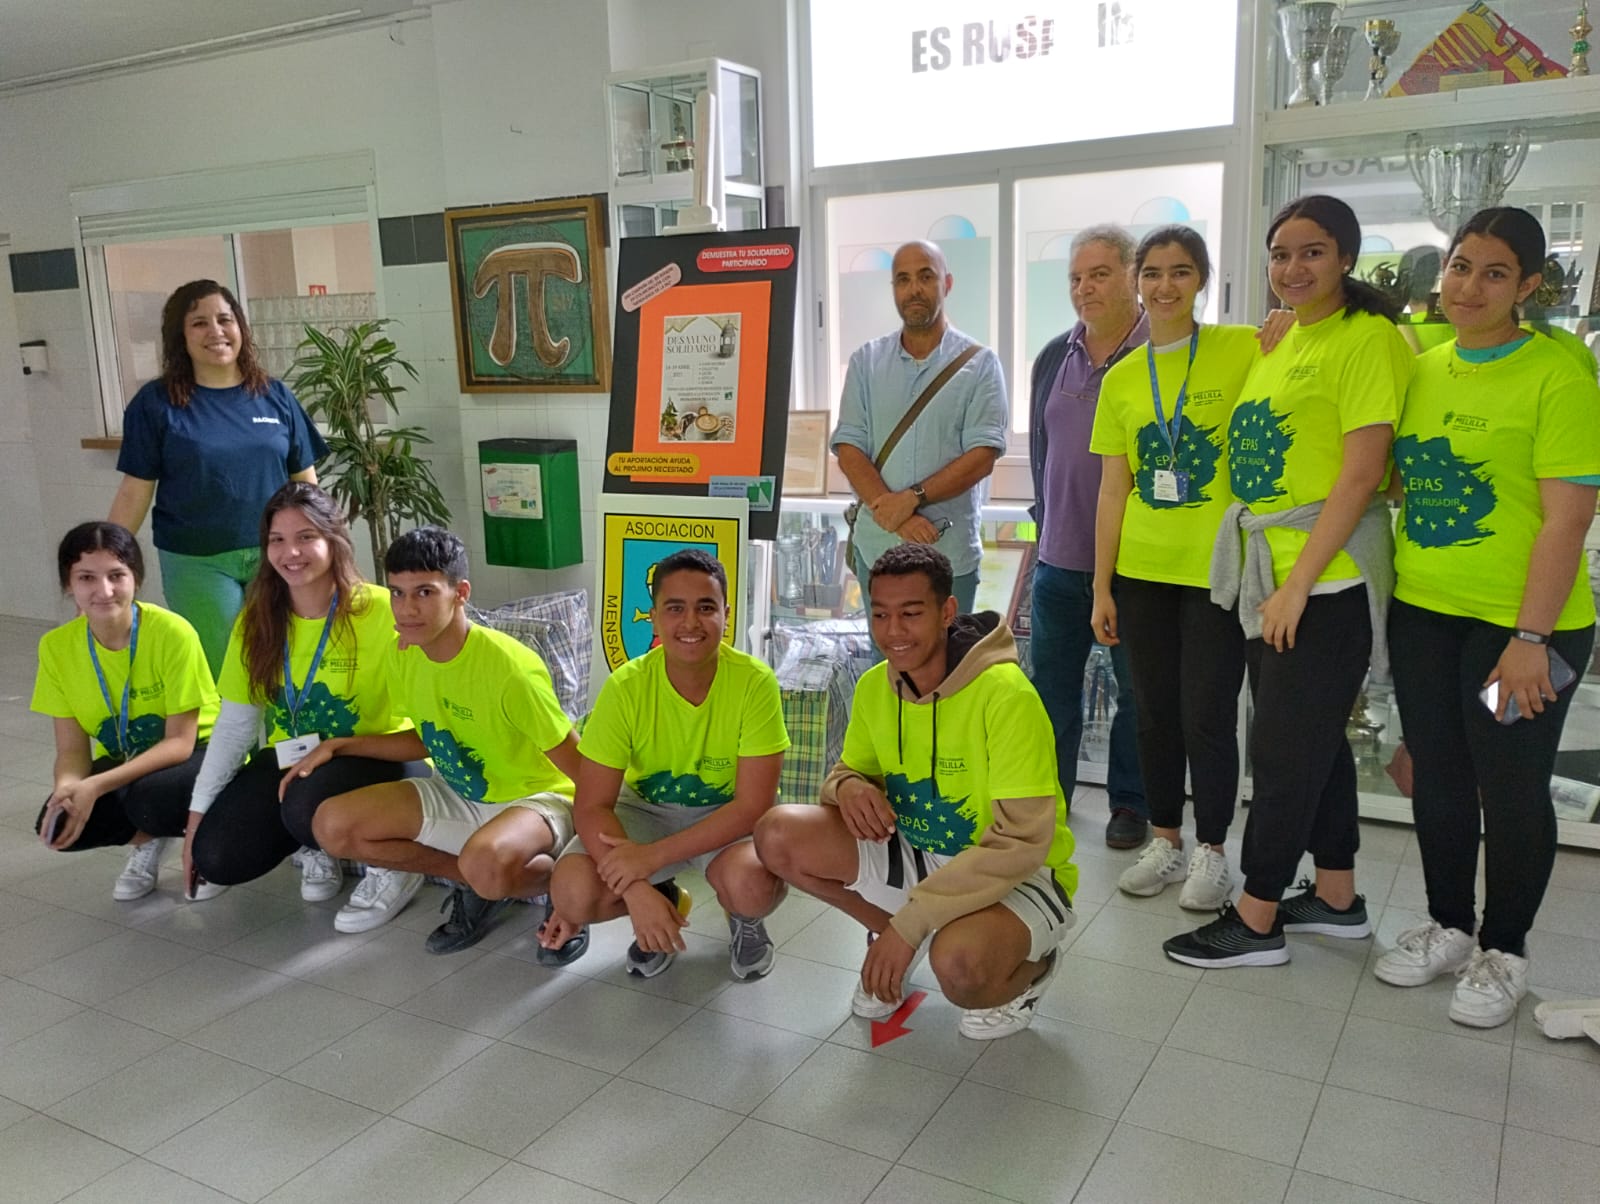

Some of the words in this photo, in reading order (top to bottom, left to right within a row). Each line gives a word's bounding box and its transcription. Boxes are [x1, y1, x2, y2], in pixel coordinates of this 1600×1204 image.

[702, 250, 737, 260] DEMUESTRA
[738, 249, 746, 257] TU
[747, 247, 790, 257] SOLIDARIDAD
[721, 258, 768, 268] PARTICIPANDO
[667, 335, 717, 345] DESAYUNO
[666, 344, 717, 354] SOLIDARIO
[1193, 392, 1223, 402] MELILLA
[1455, 417, 1487, 429] MELILLA
[1240, 438, 1259, 451] EPAS
[653, 465, 694, 474] NECESITADO
[1409, 477, 1444, 492] EPAS
[1422, 497, 1461, 508] RUSADIR
[625, 521, 715, 539] ASOCIACION
[899, 814, 930, 832] EPAS
